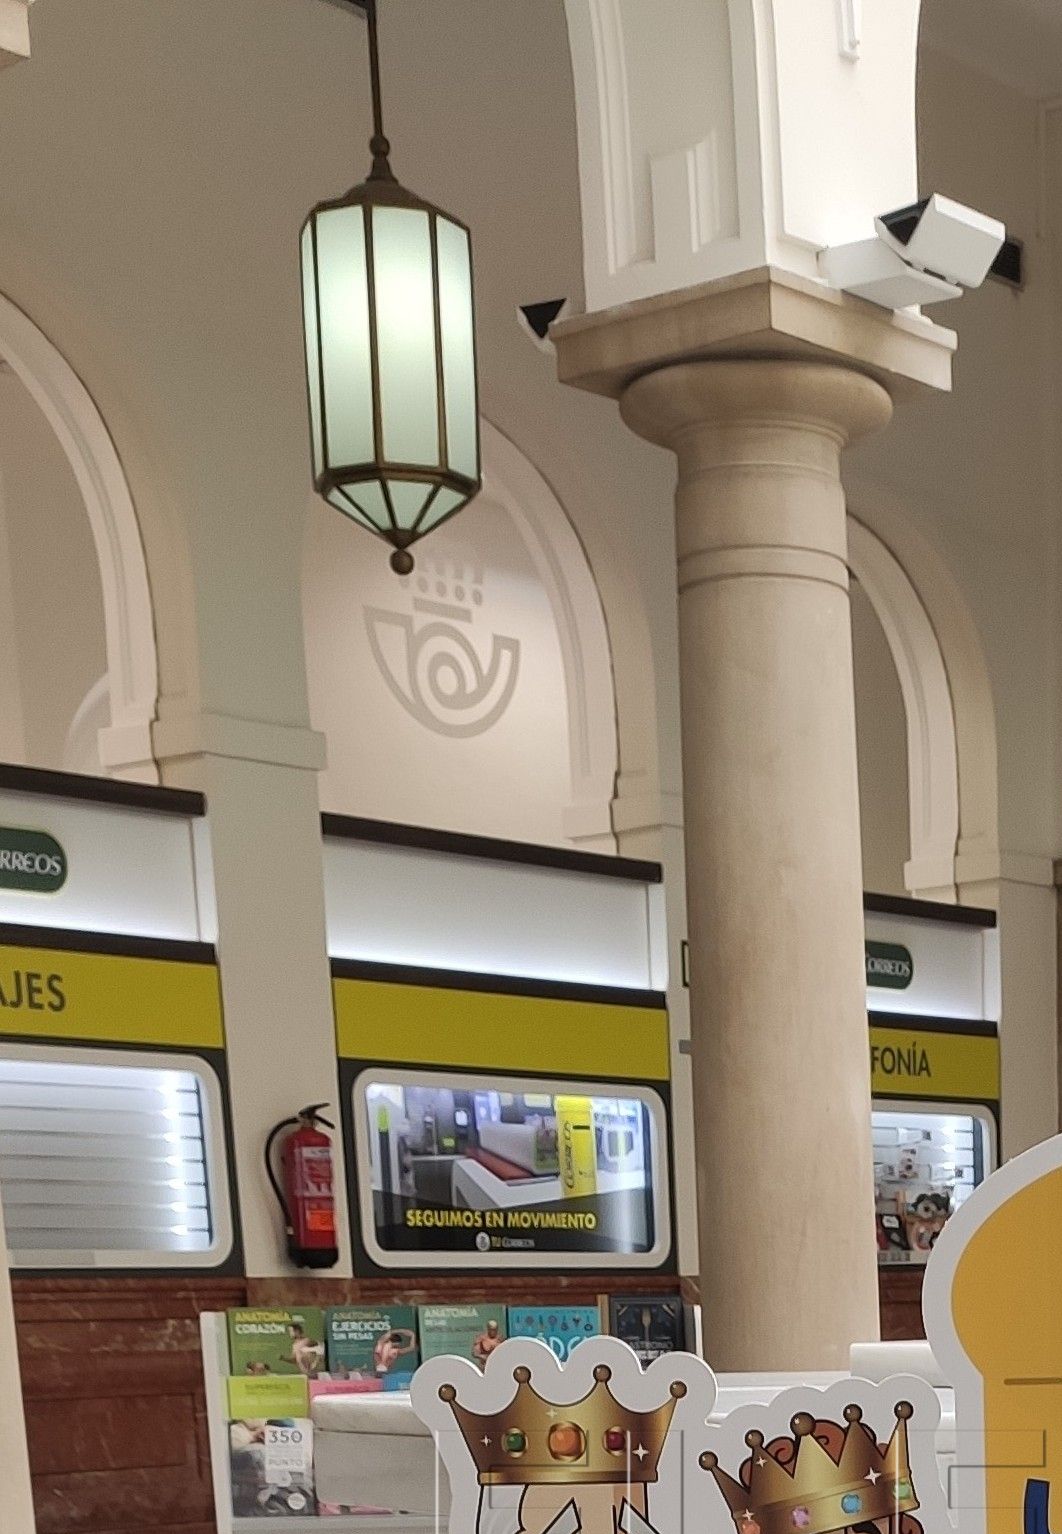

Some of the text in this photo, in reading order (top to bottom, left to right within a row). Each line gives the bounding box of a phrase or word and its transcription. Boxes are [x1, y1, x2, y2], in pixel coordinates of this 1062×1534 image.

[0, 970, 67, 1012] JES
[406, 1208, 597, 1231] SEGUIMOS EN MOVIMIENTO
[268, 1430, 303, 1443] 350
